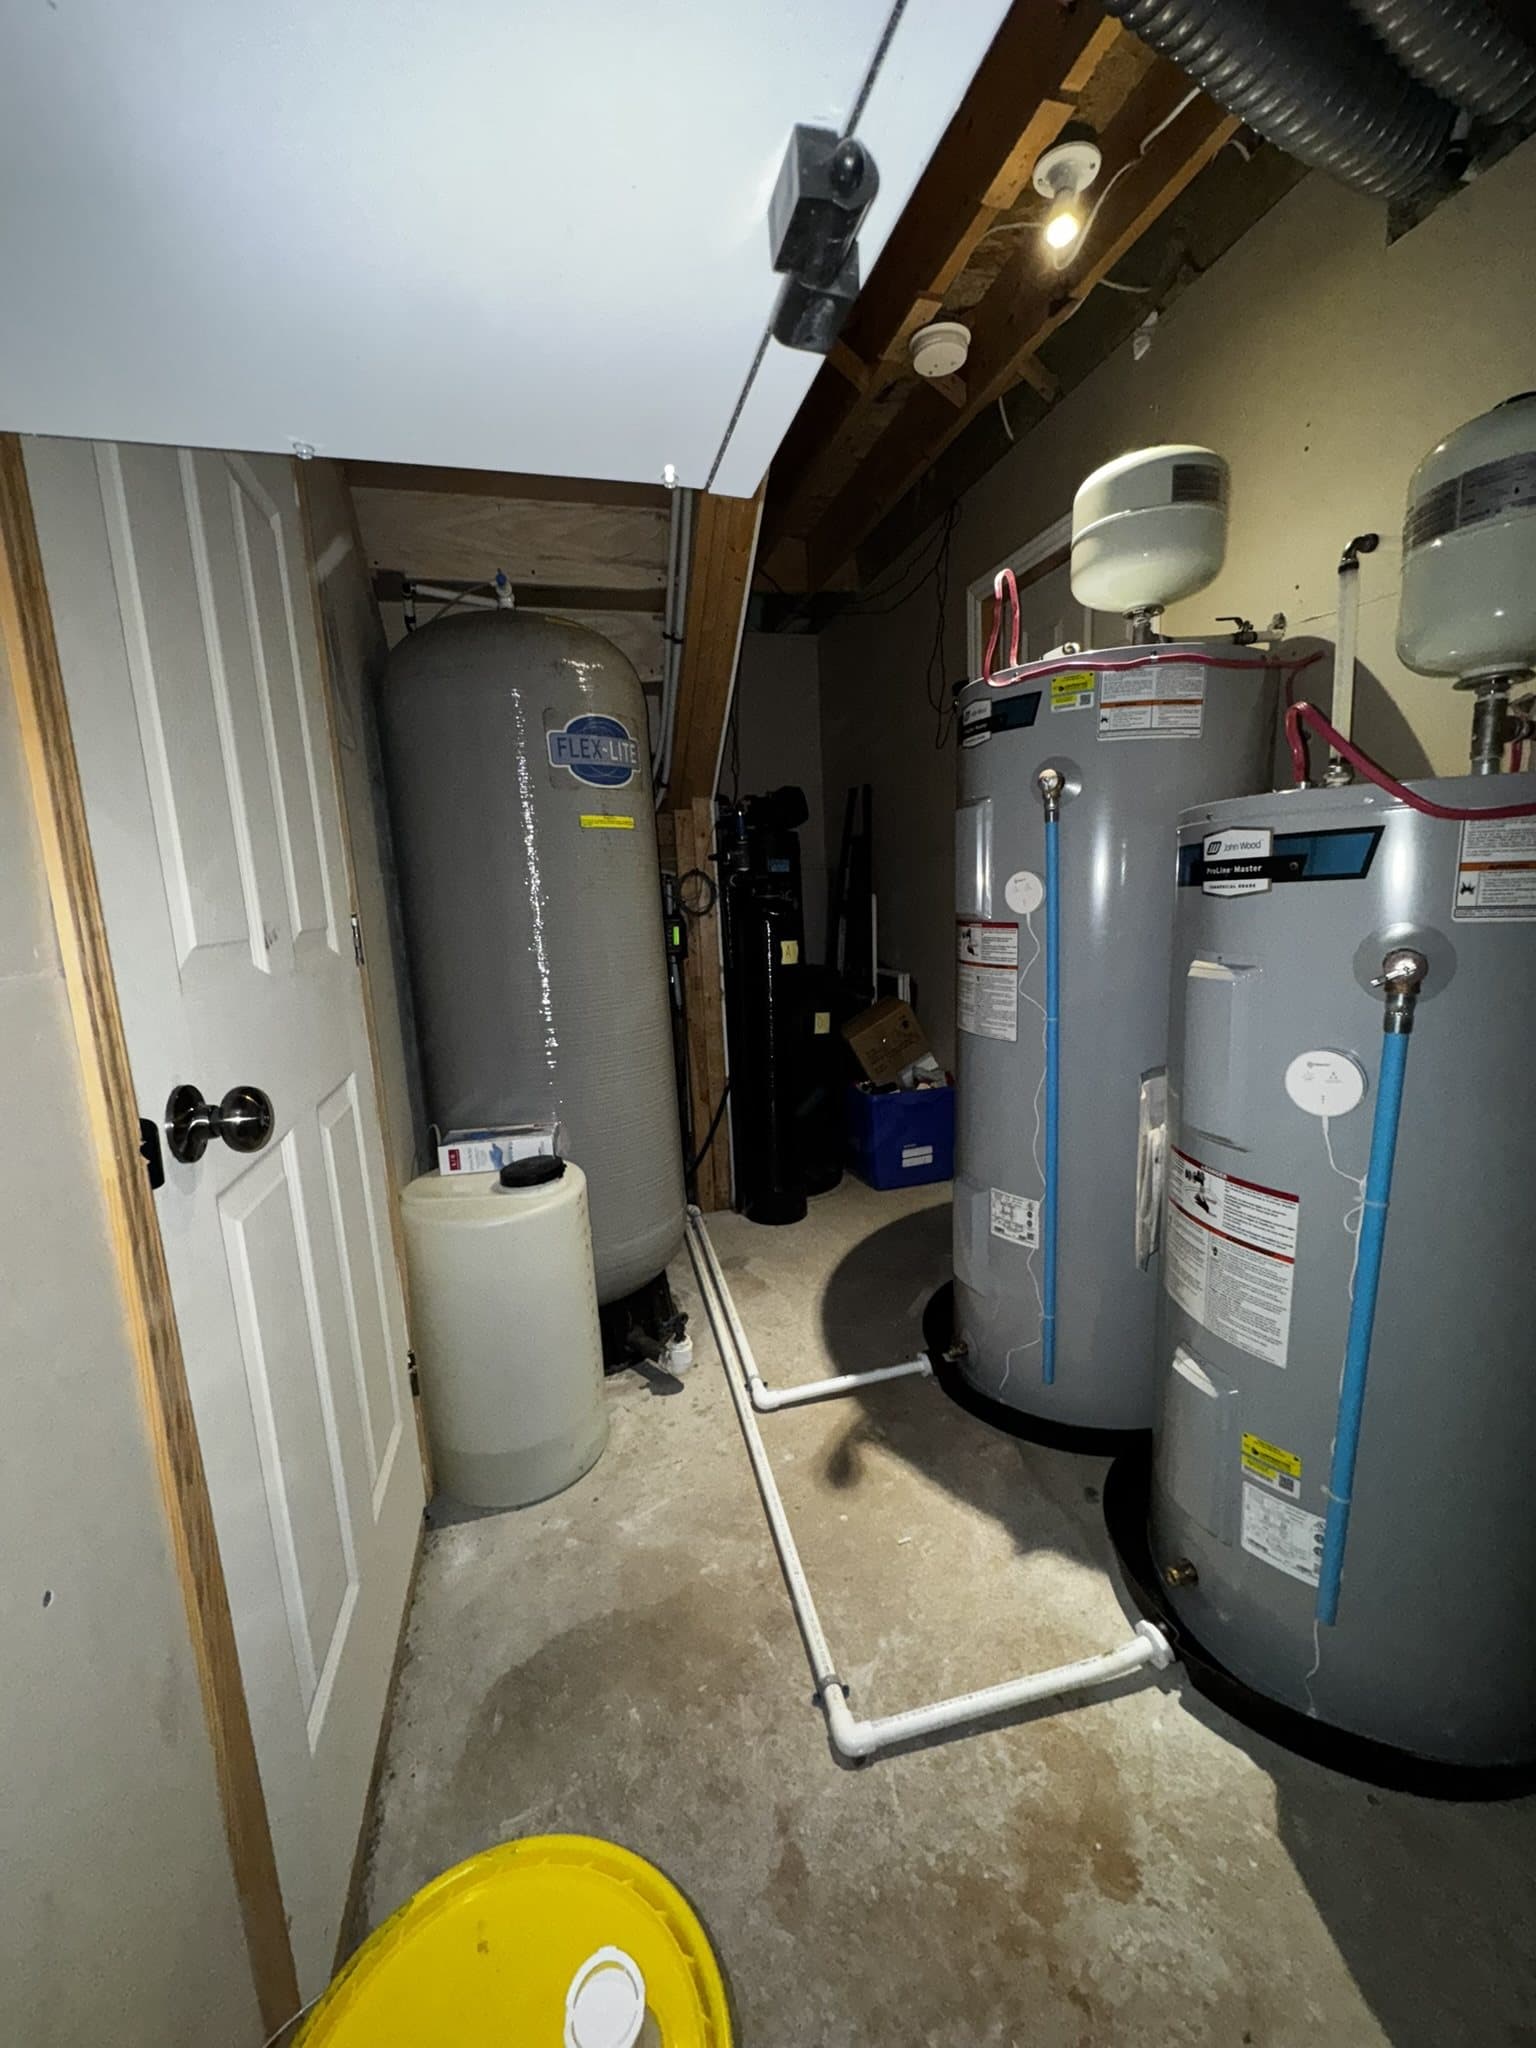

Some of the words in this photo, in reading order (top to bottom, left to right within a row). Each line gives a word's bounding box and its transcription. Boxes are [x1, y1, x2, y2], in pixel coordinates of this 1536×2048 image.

[556, 736, 638, 764] FLEX-LITE
[1224, 842, 1239, 852] John
[1240, 839, 1261, 850] Wood
[1233, 864, 1262, 873] Master
